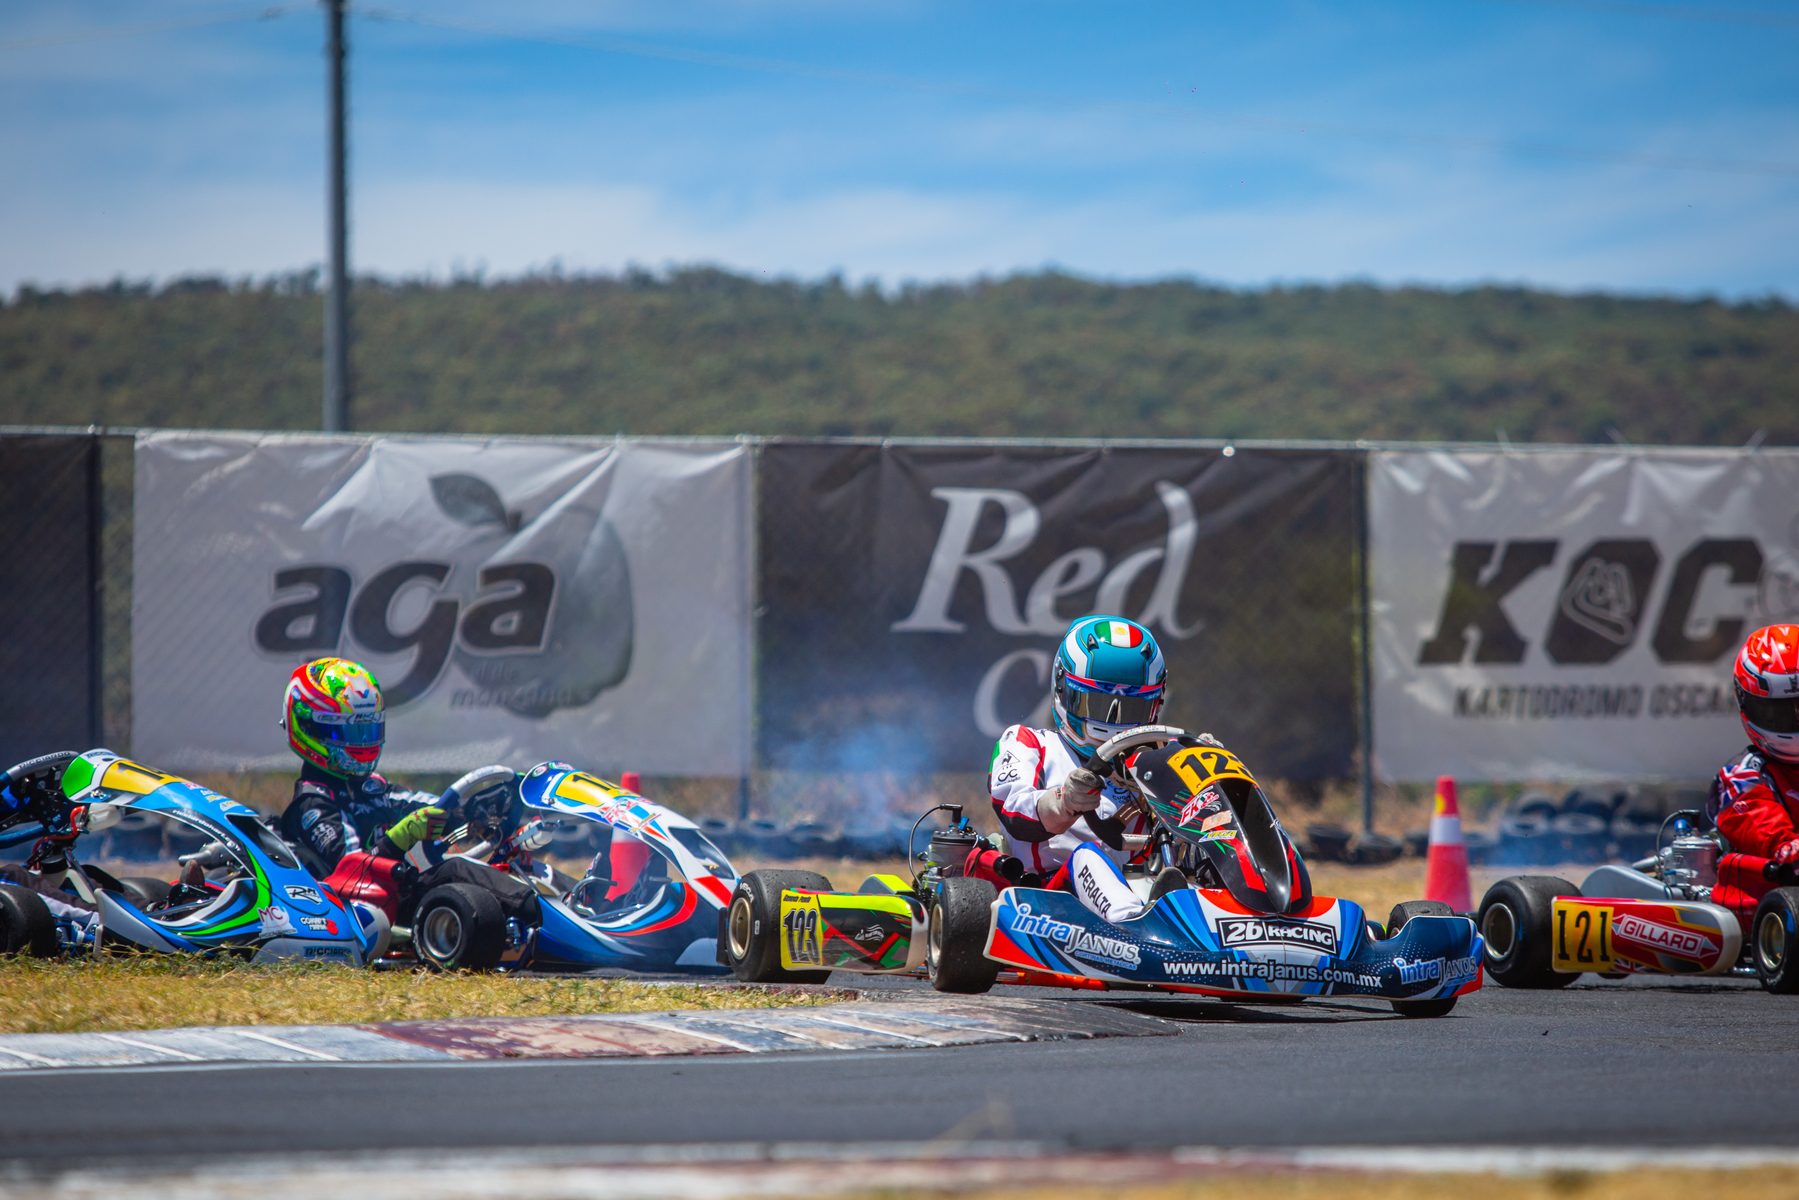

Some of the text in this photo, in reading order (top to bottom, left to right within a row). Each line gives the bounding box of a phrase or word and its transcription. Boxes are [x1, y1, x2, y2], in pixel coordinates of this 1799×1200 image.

[890, 480, 1206, 640] Red
[1417, 537, 1765, 665] KOC
[253, 561, 557, 708] aga
[1453, 684, 1644, 719] KARTODROMO
[1077, 864, 1112, 920] PERALTA
[1267, 925, 1333, 945] RACING
[1557, 909, 1610, 964] 121
[1623, 919, 1699, 952] GILLARD
[1162, 959, 1384, 989] www.intrajanus.com.mx
